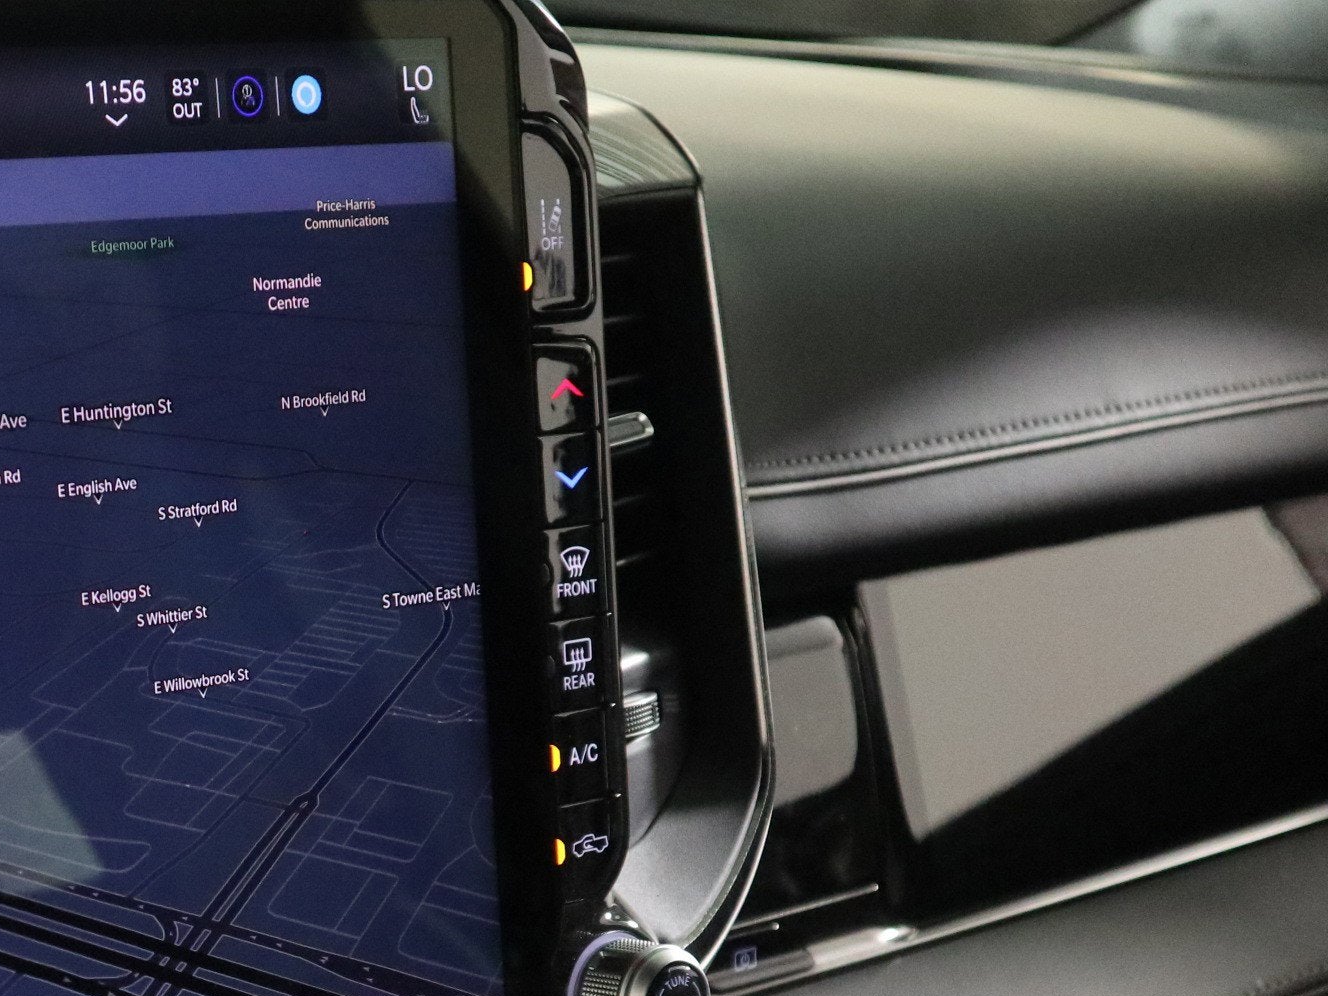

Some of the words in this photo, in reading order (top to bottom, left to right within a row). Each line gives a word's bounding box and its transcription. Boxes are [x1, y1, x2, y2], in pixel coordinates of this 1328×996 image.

[172, 77, 200, 97] 83°
[402, 65, 433, 92] LO
[85, 79, 146, 105] 11:56
[173, 102, 202, 119] OUT
[316, 198, 376, 212] Price-Harris
[304, 214, 390, 230] Communications
[90, 238, 147, 255] Edgemoor
[150, 236, 175, 250] Park
[541, 236, 564, 251] OFF
[252, 273, 322, 293] Normandie
[267, 294, 310, 312] Centre
[281, 396, 290, 410] N
[292, 391, 349, 408] Brookfield
[351, 390, 366, 403] Rd
[61, 407, 70, 424] E
[73, 401, 155, 424] Huntington
[158, 399, 172, 416] St
[0, 414, 27, 430] Ave
[4, 469, 21, 484] Rd
[58, 483, 66, 498] E
[68, 479, 112, 498] English
[115, 477, 137, 491] Ave
[158, 507, 166, 521] S
[168, 501, 219, 519] Stratford
[221, 499, 237, 514] Rd
[81, 592, 89, 606] E
[91, 587, 136, 607] Kellogg
[138, 584, 151, 599] St
[382, 594, 390, 609] S
[392, 591, 433, 607] Towne
[436, 586, 461, 601] East
[557, 578, 597, 598] FRONT
[137, 614, 144, 627] S
[146, 608, 193, 626] Whittier
[194, 605, 207, 620] St
[154, 681, 161, 695] E
[163, 672, 235, 693] Willowbrook
[238, 669, 249, 683] St
[563, 672, 596, 691] REAR
[569, 742, 599, 767] A/C
[665, 974, 691, 991] TUNE
